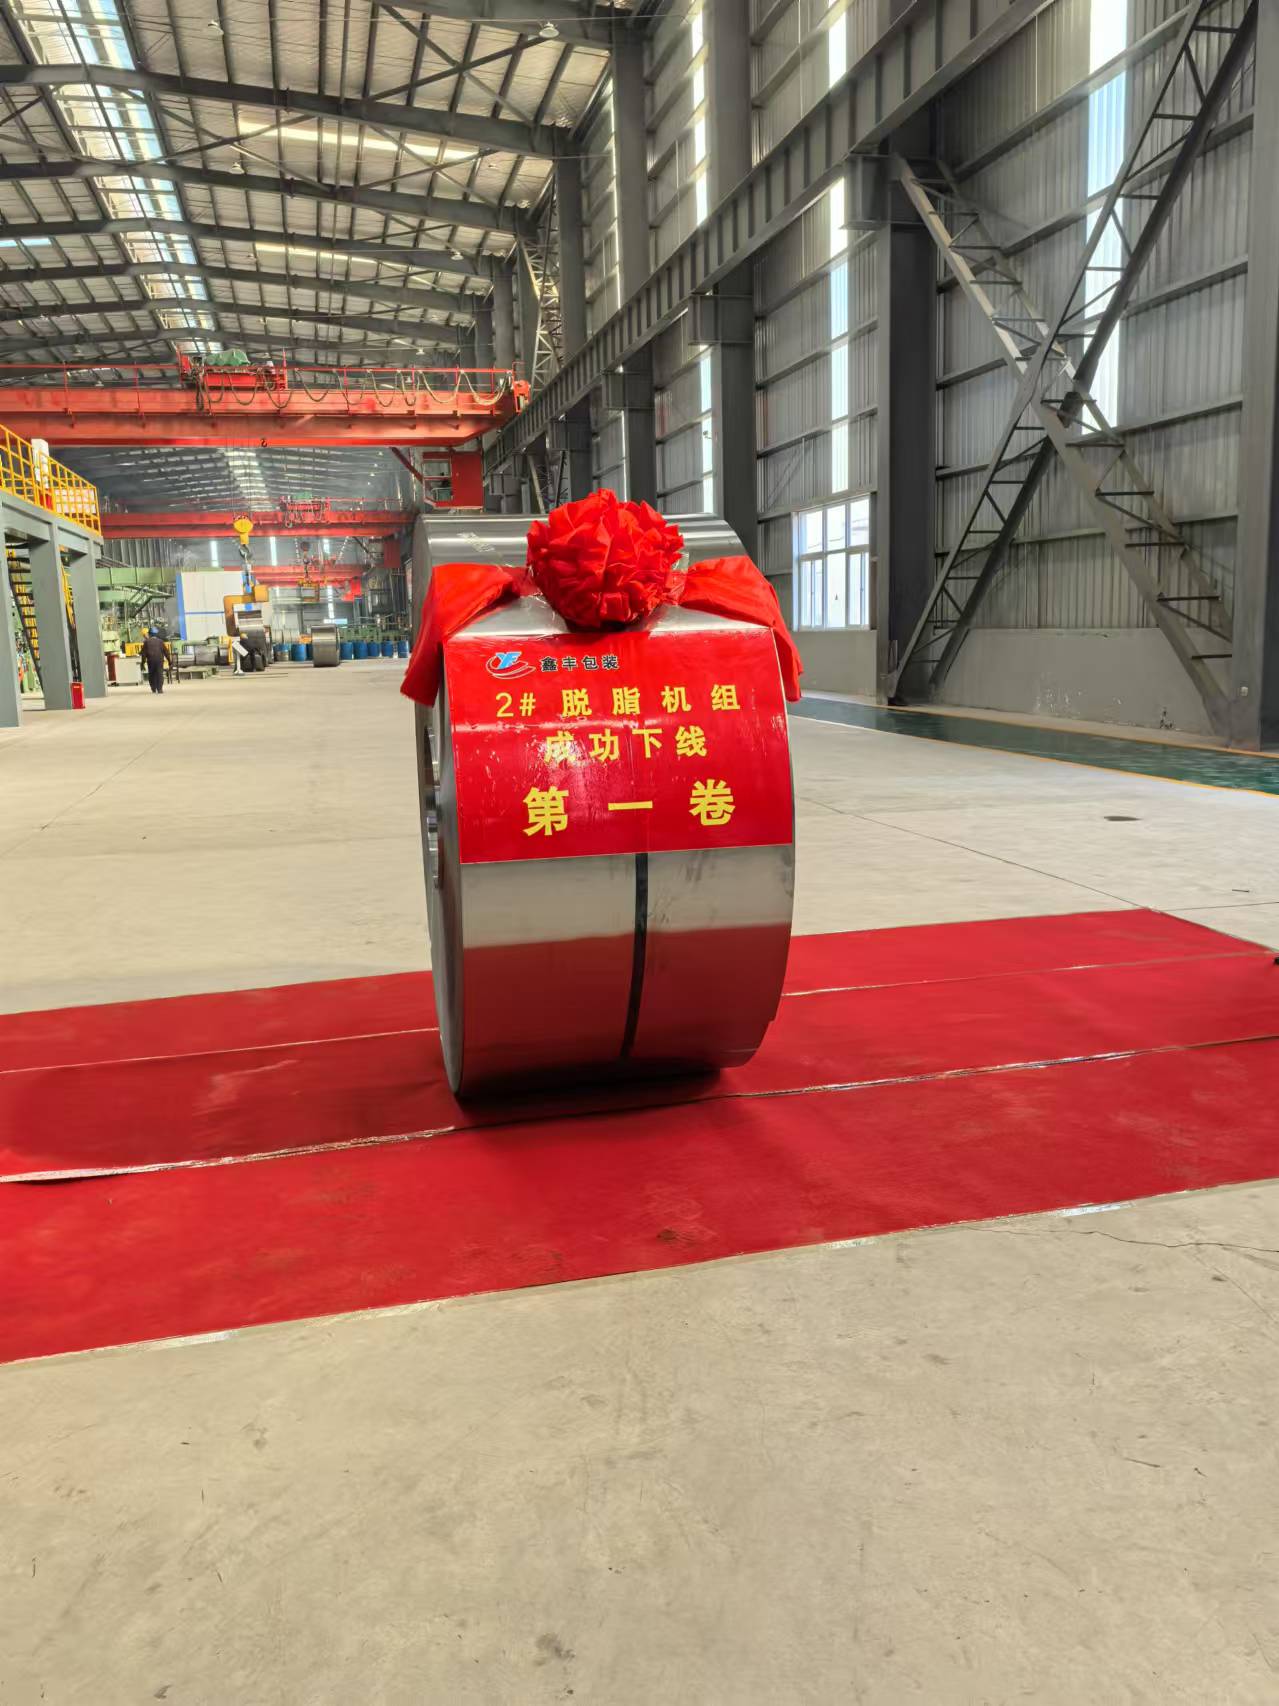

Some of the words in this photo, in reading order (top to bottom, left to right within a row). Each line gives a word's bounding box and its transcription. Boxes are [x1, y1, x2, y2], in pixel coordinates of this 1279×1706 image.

[540, 655, 619, 672] 鑫丰包装
[544, 725, 708, 763] 成功下线
[522, 779, 736, 836] 第一卷
